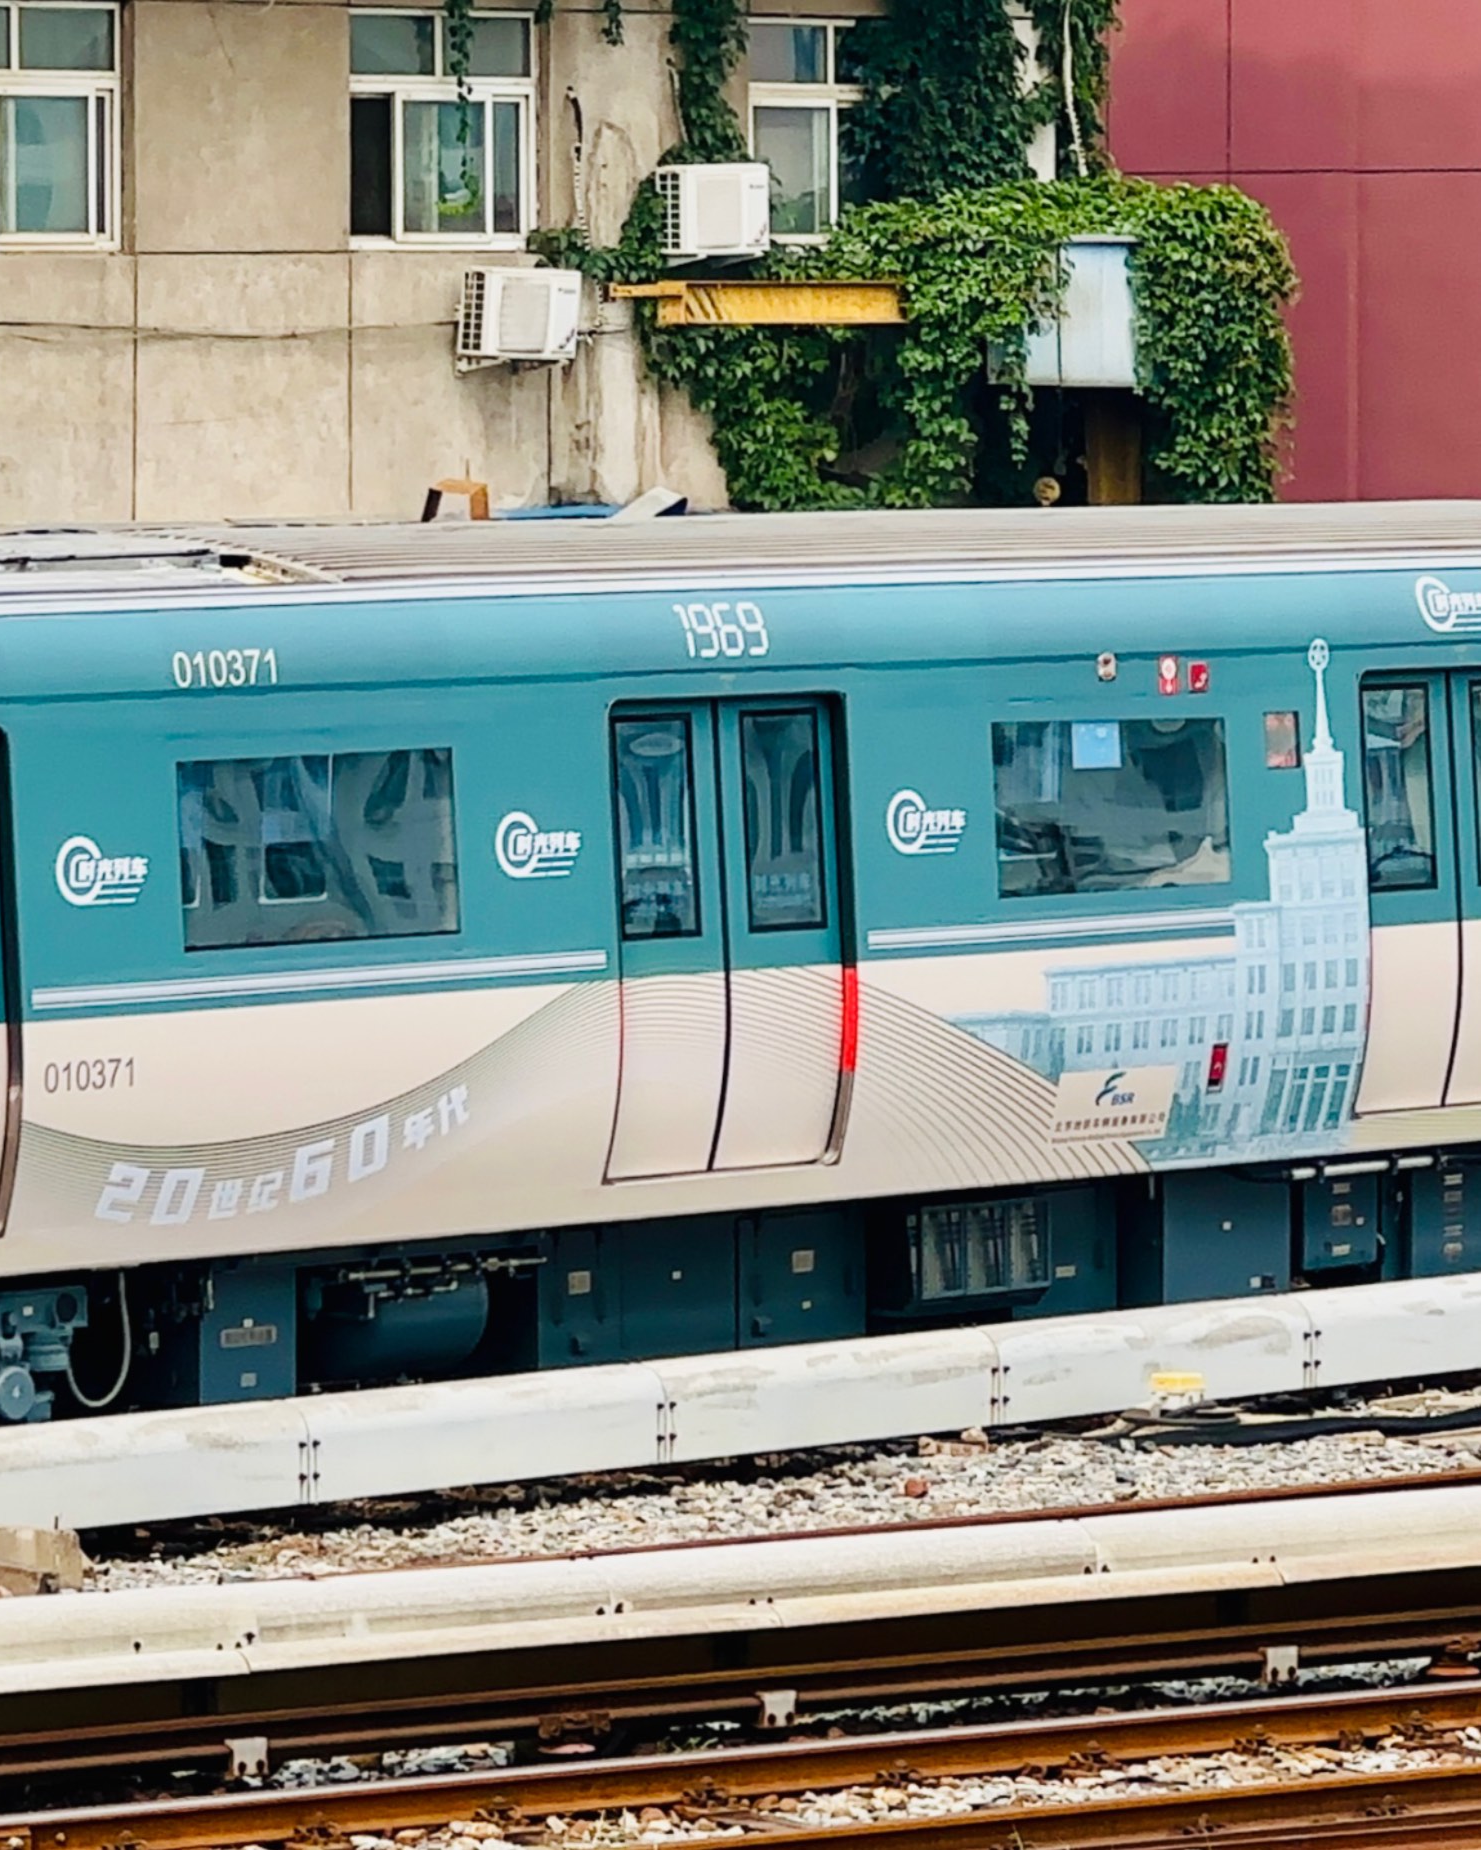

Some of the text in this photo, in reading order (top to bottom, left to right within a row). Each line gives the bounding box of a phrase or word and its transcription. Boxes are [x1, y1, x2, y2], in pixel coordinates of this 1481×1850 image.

[672, 602, 769, 658] 1969
[172, 648, 278, 688] 010371
[906, 809, 966, 832] 时光列车
[516, 831, 582, 855] 时光列车
[78, 856, 149, 881] 时光列车
[44, 1057, 134, 1094] 010371
[1111, 1091, 1135, 1106] BSR
